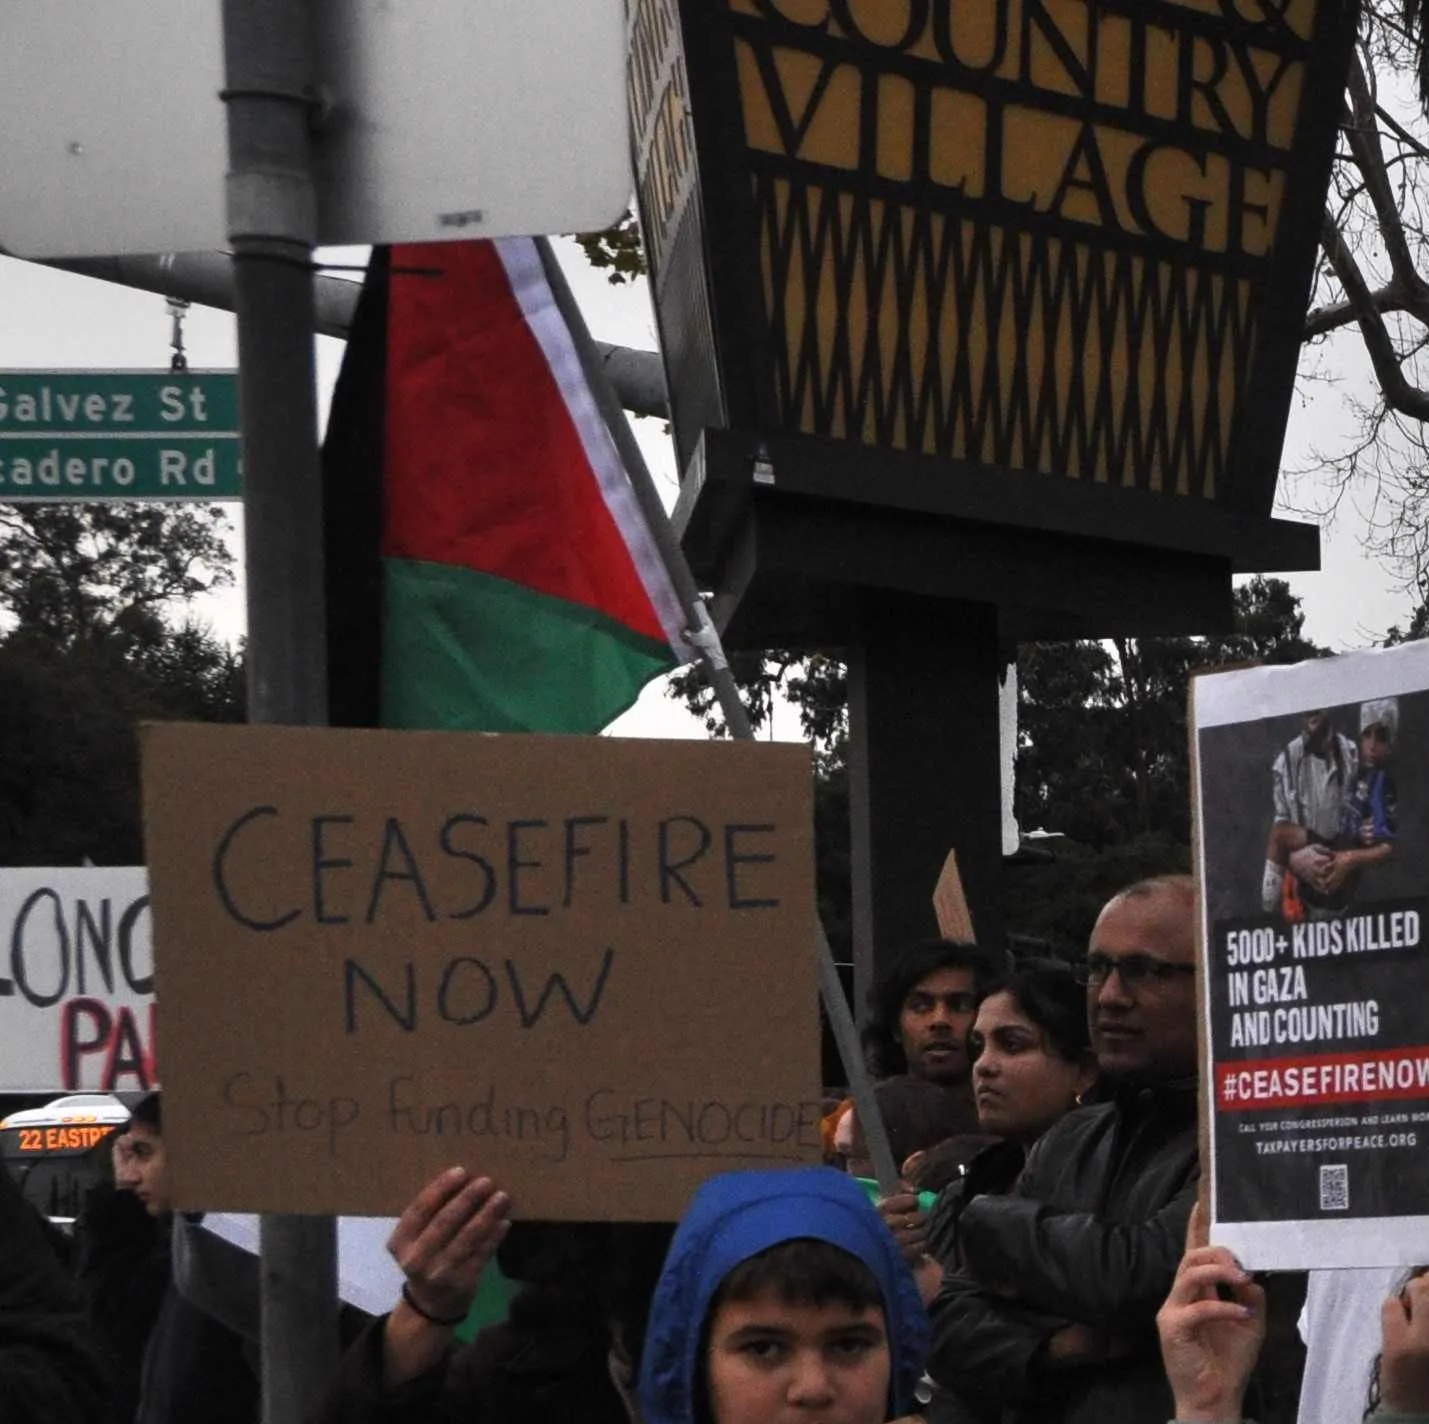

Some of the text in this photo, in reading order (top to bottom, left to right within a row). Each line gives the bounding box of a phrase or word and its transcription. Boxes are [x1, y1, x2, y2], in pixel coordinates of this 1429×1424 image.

[743, 38, 1285, 256] VILLAGE
[159, 385, 208, 422] St
[0, 447, 216, 486] adero Rd
[213, 806, 780, 932] CEASEFIRE
[1227, 909, 1421, 967] 5000+ KIDS KILLED
[343, 948, 614, 1034] NOW
[1228, 964, 1309, 1008] IN GAZA
[59, 996, 158, 1092] PA
[1230, 999, 1380, 1049] AND COUNTING
[222, 1072, 360, 1149] Stop
[589, 1089, 819, 1149] GENOCIDE
[1238, 1123, 1257, 1133] CALL
[1361, 1115, 1379, 1126] AND
[18, 1129, 42, 1151] 22
[1255, 1133, 1417, 1155] TAXPAYERSFORPEACE.ORG
